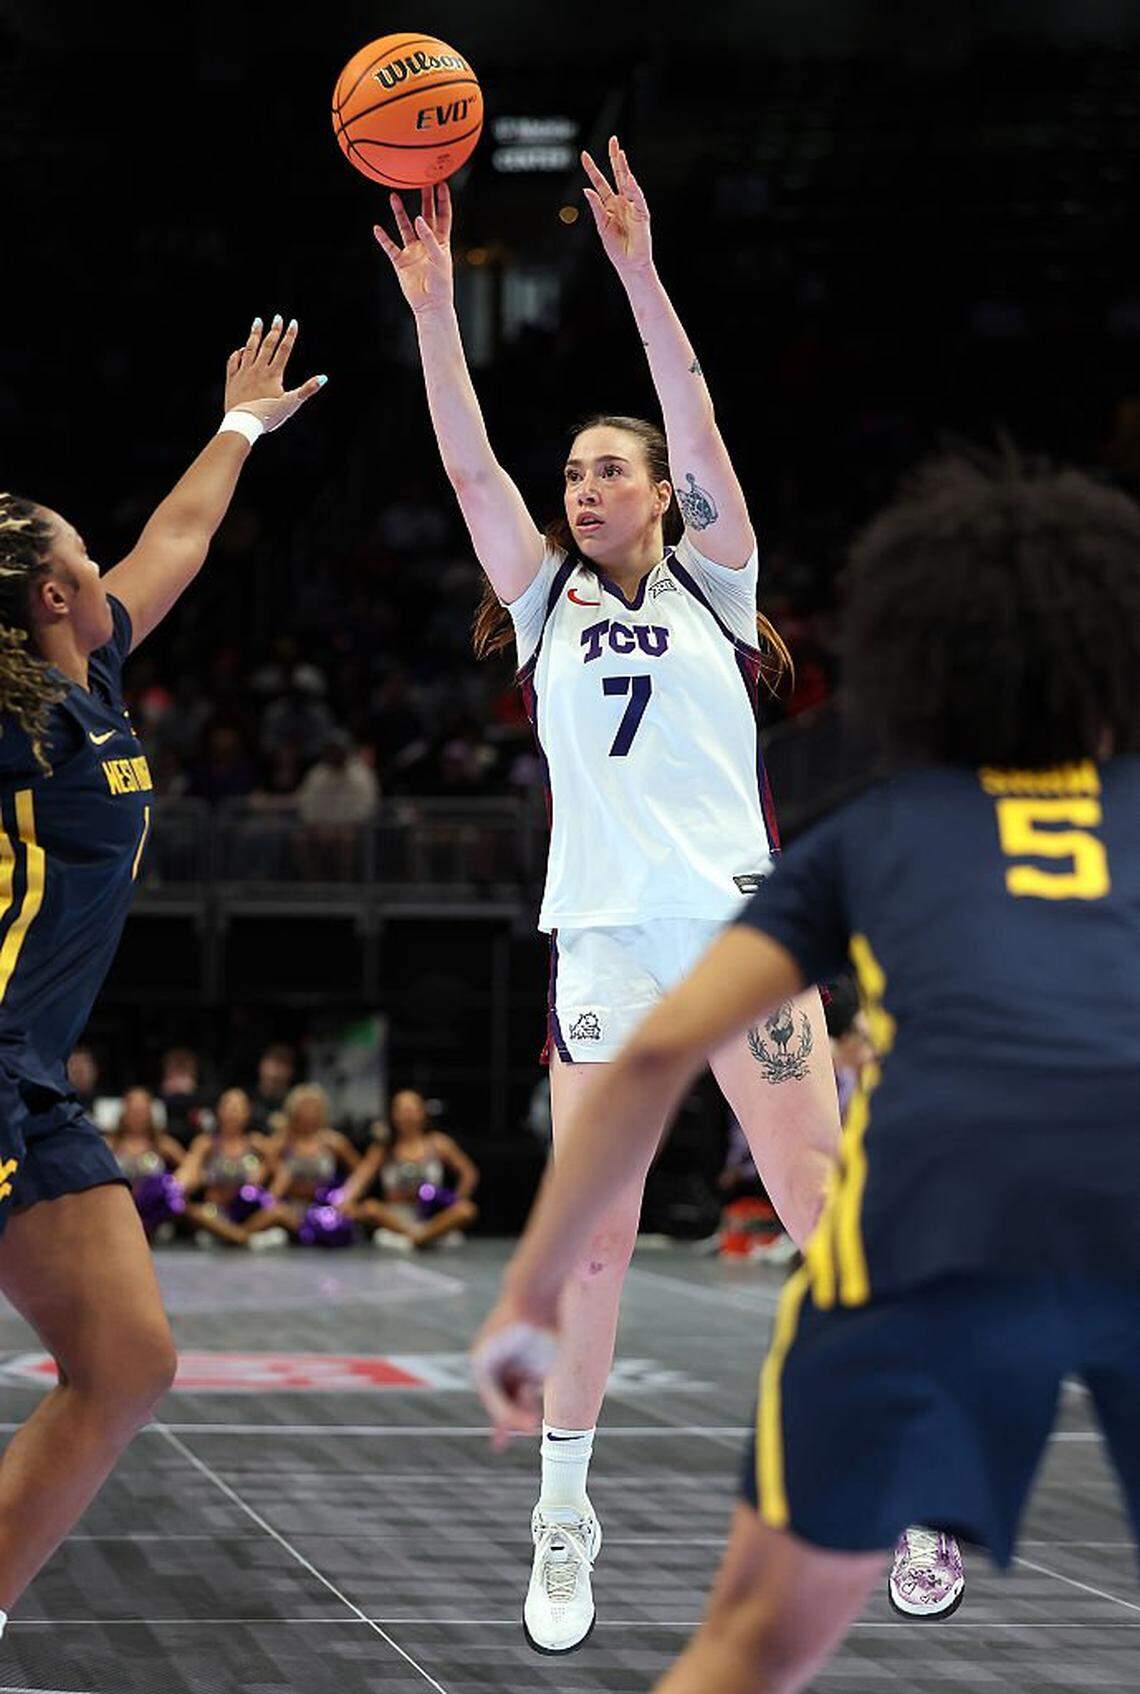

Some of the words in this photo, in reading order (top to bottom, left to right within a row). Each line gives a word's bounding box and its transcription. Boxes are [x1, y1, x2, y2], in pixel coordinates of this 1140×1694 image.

[374, 50, 468, 90] Wilson
[416, 100, 467, 130] EVO
[581, 619, 669, 663] TCU
[602, 675, 652, 756] 7
[996, 798, 1109, 900] 5
